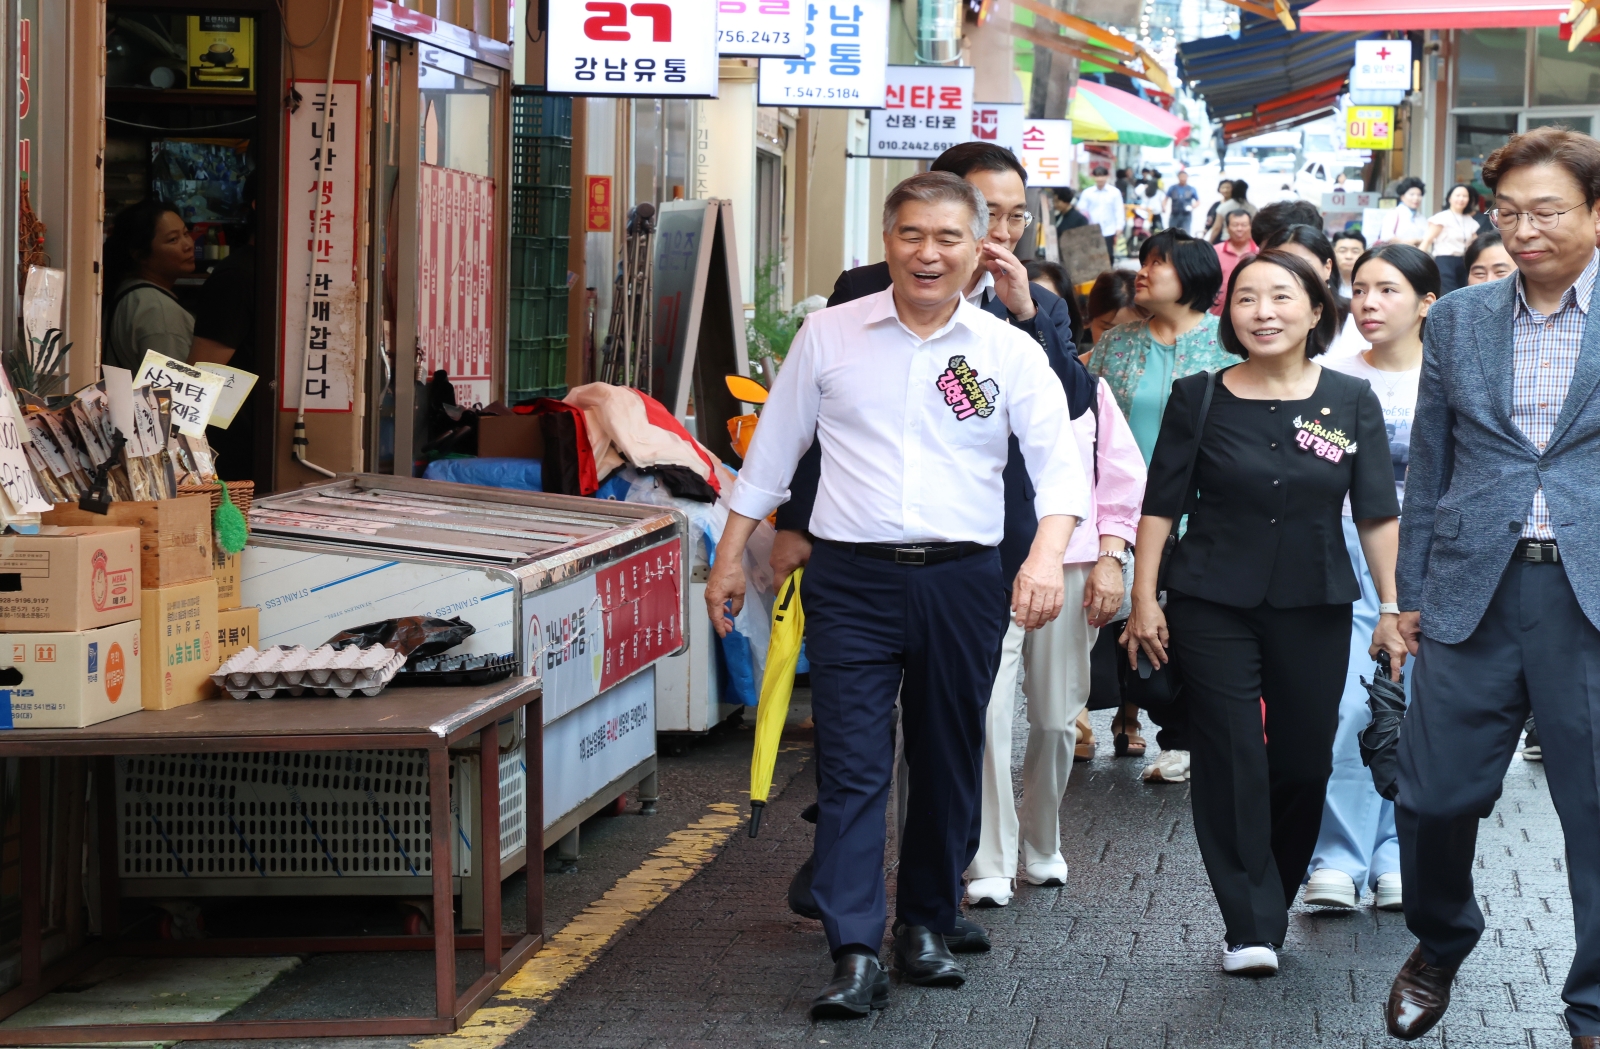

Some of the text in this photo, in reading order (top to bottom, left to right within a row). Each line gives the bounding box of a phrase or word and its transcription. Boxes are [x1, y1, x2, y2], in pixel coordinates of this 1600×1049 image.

[574, 57, 687, 83] 강남유통
[784, 86, 860, 99] T.547.5184
[309, 94, 338, 171] 국내산
[657, 231, 695, 271] 김은주
[145, 366, 207, 402] 삼계탕
[938, 370, 976, 420] 김현기
[955, 362, 988, 409] 강남구청장
[171, 400, 202, 425] 재료
[1301, 420, 1351, 450] 서울시의원
